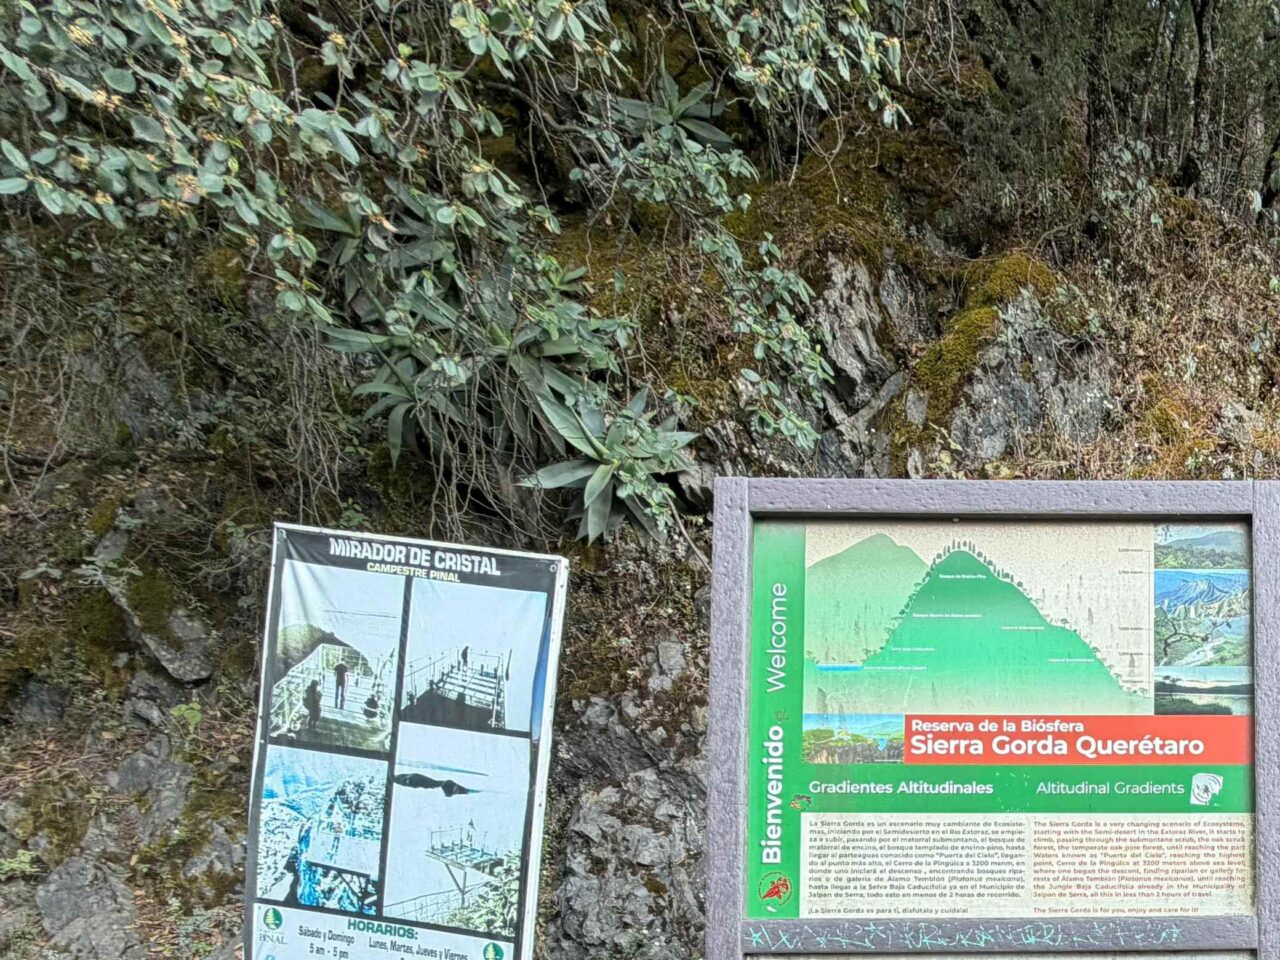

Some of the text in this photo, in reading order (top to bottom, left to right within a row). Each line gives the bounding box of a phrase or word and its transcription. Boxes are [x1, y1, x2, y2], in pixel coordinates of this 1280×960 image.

[329, 537, 501, 575] MIRADOR DE CRISTAL
[367, 562, 460, 583] CAMPESTRE PINAL
[766, 582, 788, 693] Welcome
[911, 719, 1084, 733] Reserva de la Biósfera
[910, 734, 1205, 758] Sierra Gorda Querétaro
[809, 780, 994, 794] Gradientes Altitudinales
[1036, 781, 1185, 795] Altitudinal Gradients
[761, 725, 783, 864] Bienvenido
[1126, 820, 1160, 829] changing
[887, 844, 914, 853] bosque
[914, 844, 949, 853] templado
[1184, 844, 1216, 853] reaching
[830, 884, 851, 892] llegar
[889, 884, 906, 892] Baja
[979, 884, 1014, 892] Municipio
[808, 892, 832, 900] Jalpan
[1033, 892, 1057, 900] Jalpan
[299, 925, 322, 940] Sábado
[322, 931, 327, 942] y
[327, 930, 355, 946] Domingo
[347, 918, 419, 940] HORARIOS:
[259, 933, 288, 944] PINAL
[309, 943, 314, 953] 5
[315, 946, 325, 955] am
[333, 947, 338, 957] 5
[338, 950, 349, 960] pm
[368, 937, 389, 953] Lunes,
[390, 941, 415, 957] Martes,
[415, 944, 438, 958] Jueves
[438, 949, 444, 960] y
